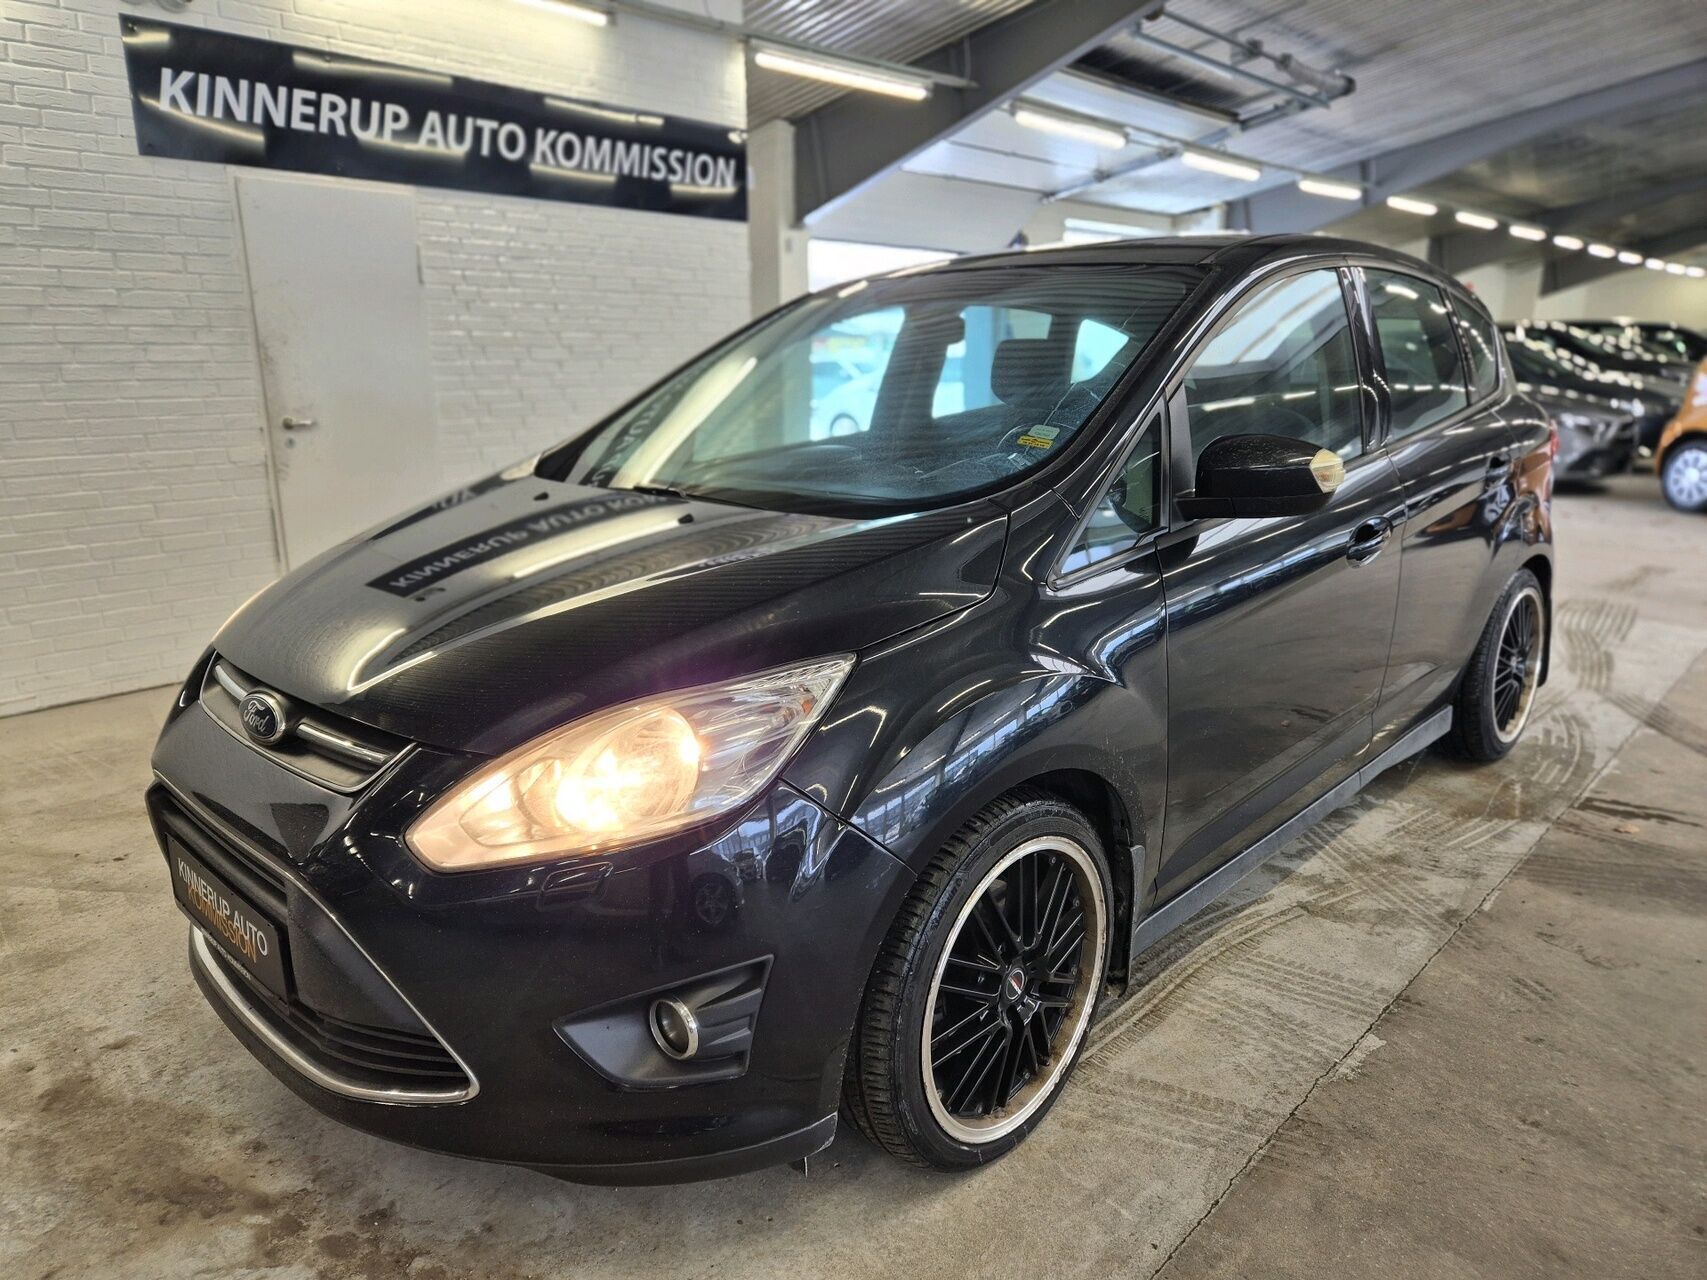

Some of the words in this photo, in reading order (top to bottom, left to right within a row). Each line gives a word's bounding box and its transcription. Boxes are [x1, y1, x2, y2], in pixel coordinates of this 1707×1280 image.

[159, 67, 409, 143] KINNERUP
[417, 110, 526, 161] AUTO
[534, 128, 736, 188] KOMMISSION
[243, 700, 270, 732] Ford
[177, 857, 230, 918] KINNERUP
[233, 911, 268, 956] AUTO
[187, 884, 257, 963] KOMMISSION
